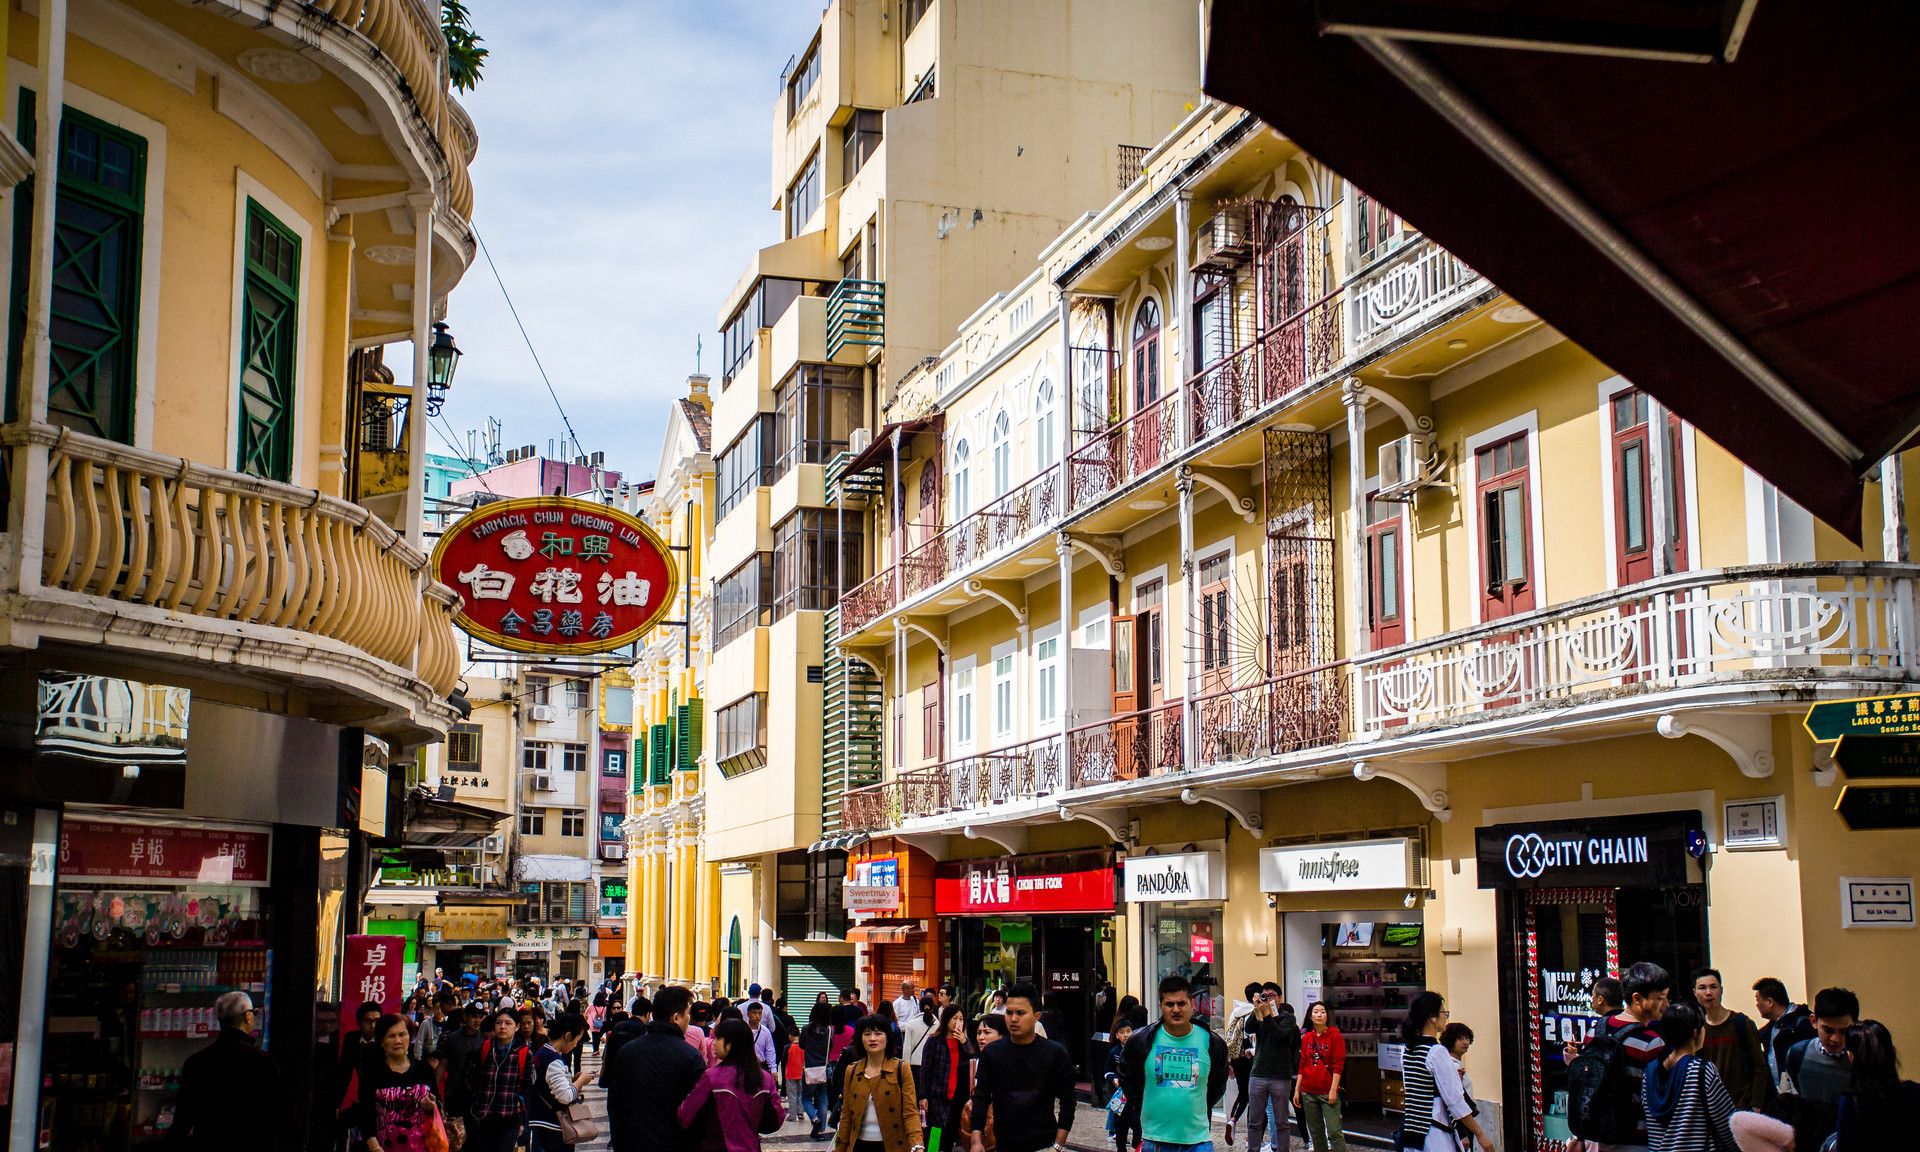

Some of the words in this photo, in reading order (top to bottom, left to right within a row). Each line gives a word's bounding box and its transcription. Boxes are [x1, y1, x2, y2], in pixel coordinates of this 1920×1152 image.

[533, 511, 564, 525] CHUN
[571, 514, 615, 535] CHEONG
[538, 531, 614, 564] 和興
[457, 563, 651, 607] 白花油
[1852, 715, 1883, 727] LARGO
[1885, 714, 1898, 724] DO
[1880, 725, 1909, 734] Senado
[1544, 841, 1583, 867] CITY
[1588, 836, 1648, 865] CHAIN
[1298, 851, 1359, 883] innisfree
[970, 868, 1010, 904] 周大福
[1045, 877, 1063, 889] FOOK
[1137, 870, 1191, 893] PANDORA
[849, 889, 890, 899] Sweetmay
[1052, 972, 1080, 982] 周大福
[1544, 971, 1576, 1003] MERRY
[1557, 1004, 1581, 1015] HAPPY
[1163, 1054, 1190, 1063] FERRIS
[1164, 1072, 1189, 1080] WHEEL
